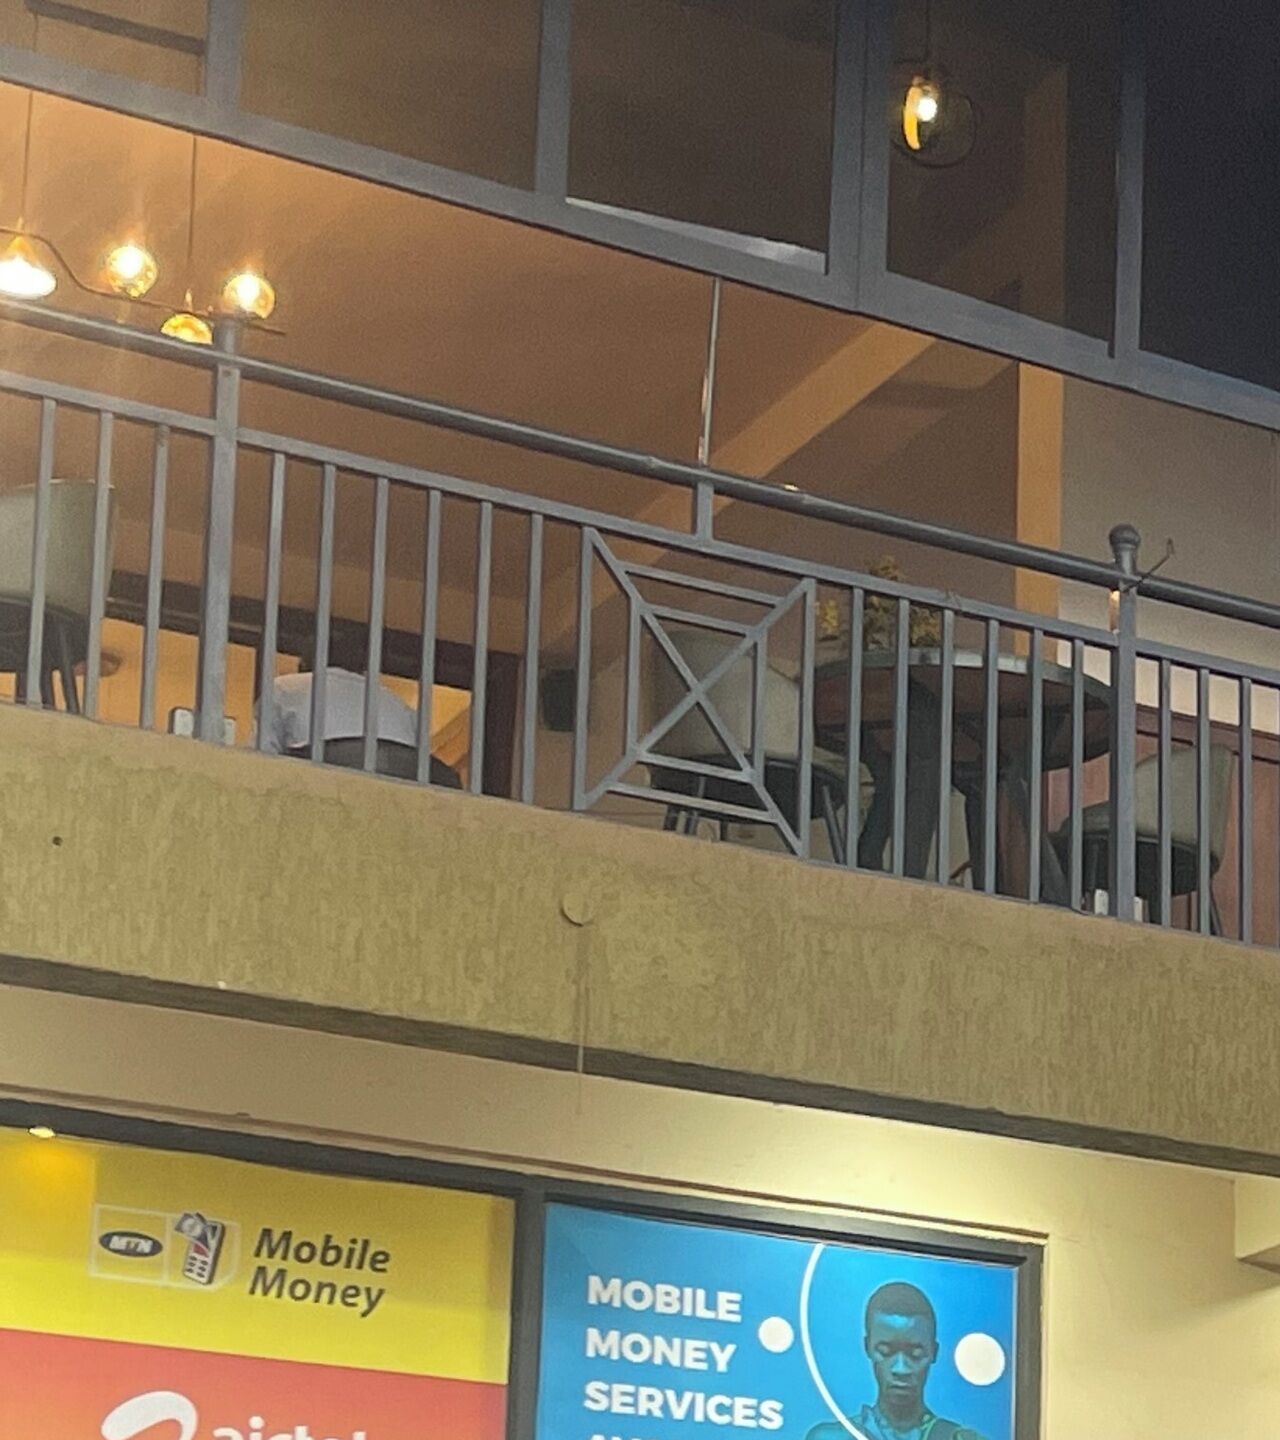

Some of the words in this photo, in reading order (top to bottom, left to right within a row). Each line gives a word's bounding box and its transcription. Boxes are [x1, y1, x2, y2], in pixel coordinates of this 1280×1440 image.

[253, 1227, 390, 1273] Mobile
[248, 1265, 385, 1318] Money
[588, 1275, 742, 1323] MOBILE
[585, 1327, 736, 1372] MONEY
[583, 1381, 784, 1430] SERVICES
